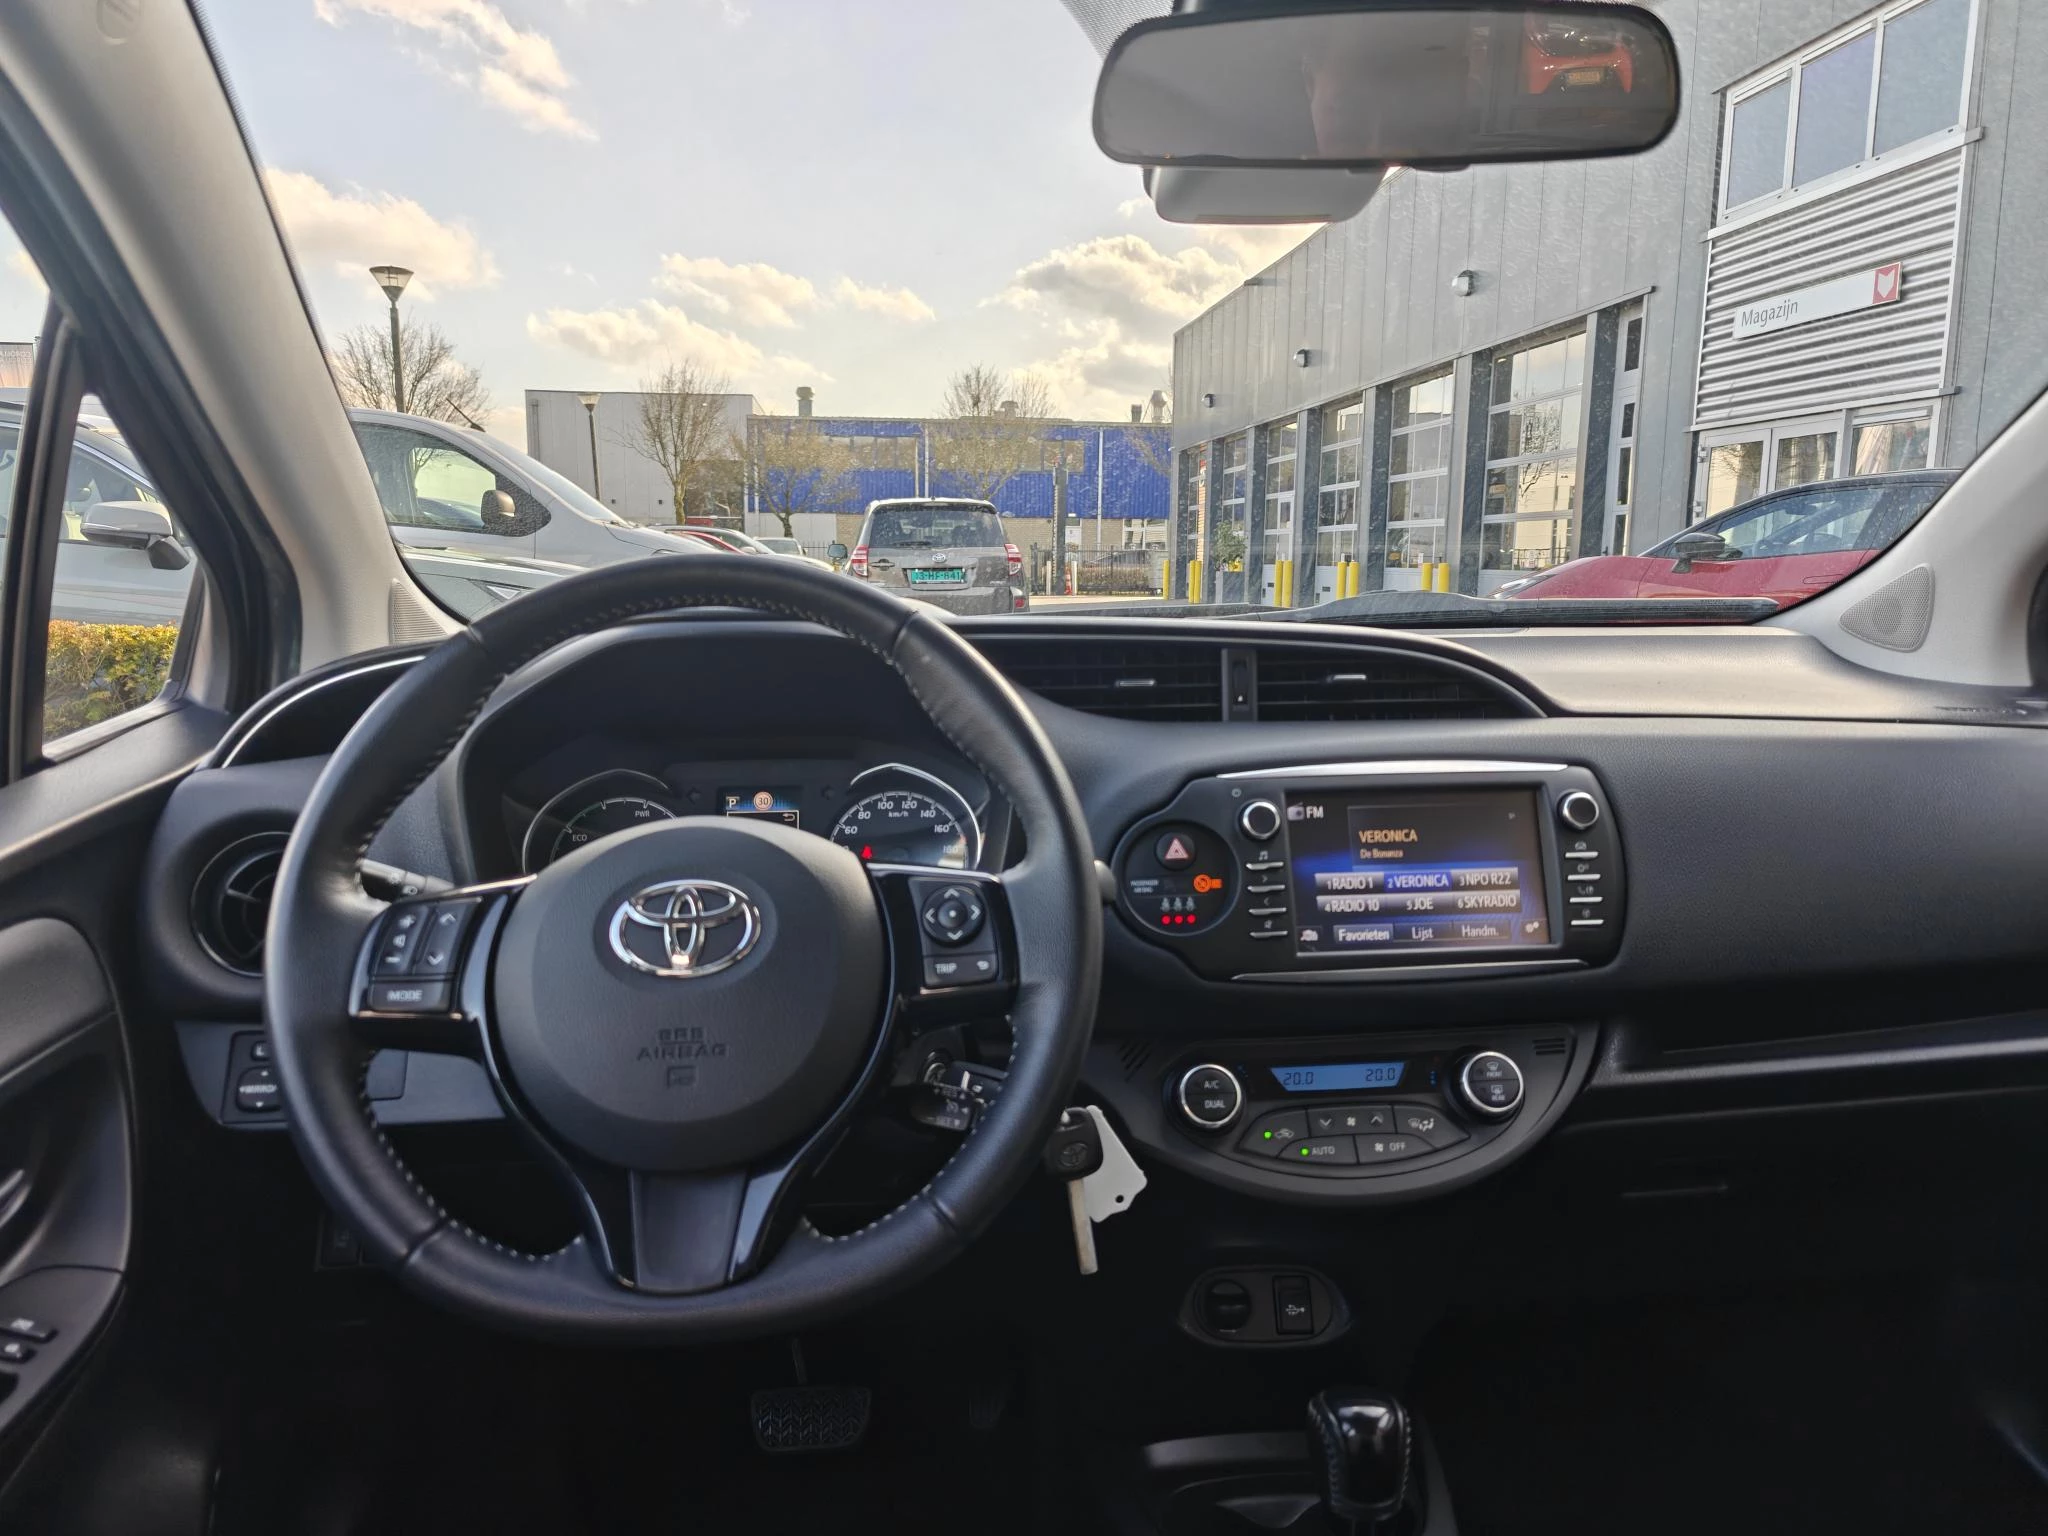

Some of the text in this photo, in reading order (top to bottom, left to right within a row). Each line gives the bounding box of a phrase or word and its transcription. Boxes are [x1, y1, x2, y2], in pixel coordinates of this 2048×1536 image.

[1741, 299, 1798, 328] Magazijn
[757, 796, 769, 806] 30
[877, 800, 918, 810] 100 120
[634, 810, 650, 818] PWR
[858, 811, 871, 820] 80
[920, 809, 936, 818] 140
[1305, 805, 1324, 819] FM
[844, 825, 858, 835] 60
[934, 824, 950, 833] 160
[572, 834, 588, 842] ECO
[1359, 829, 1418, 843] VERONICA
[1338, 928, 1390, 942] Favorieten
[1411, 926, 1434, 942] Lijst
[1283, 1067, 1396, 1086] 20.0 20.0
[1204, 1080, 1220, 1089] A/C
[1204, 1099, 1226, 1109] DUAL
[1311, 1145, 1336, 1156] AUTO
[1389, 1141, 1406, 1152] OFF
